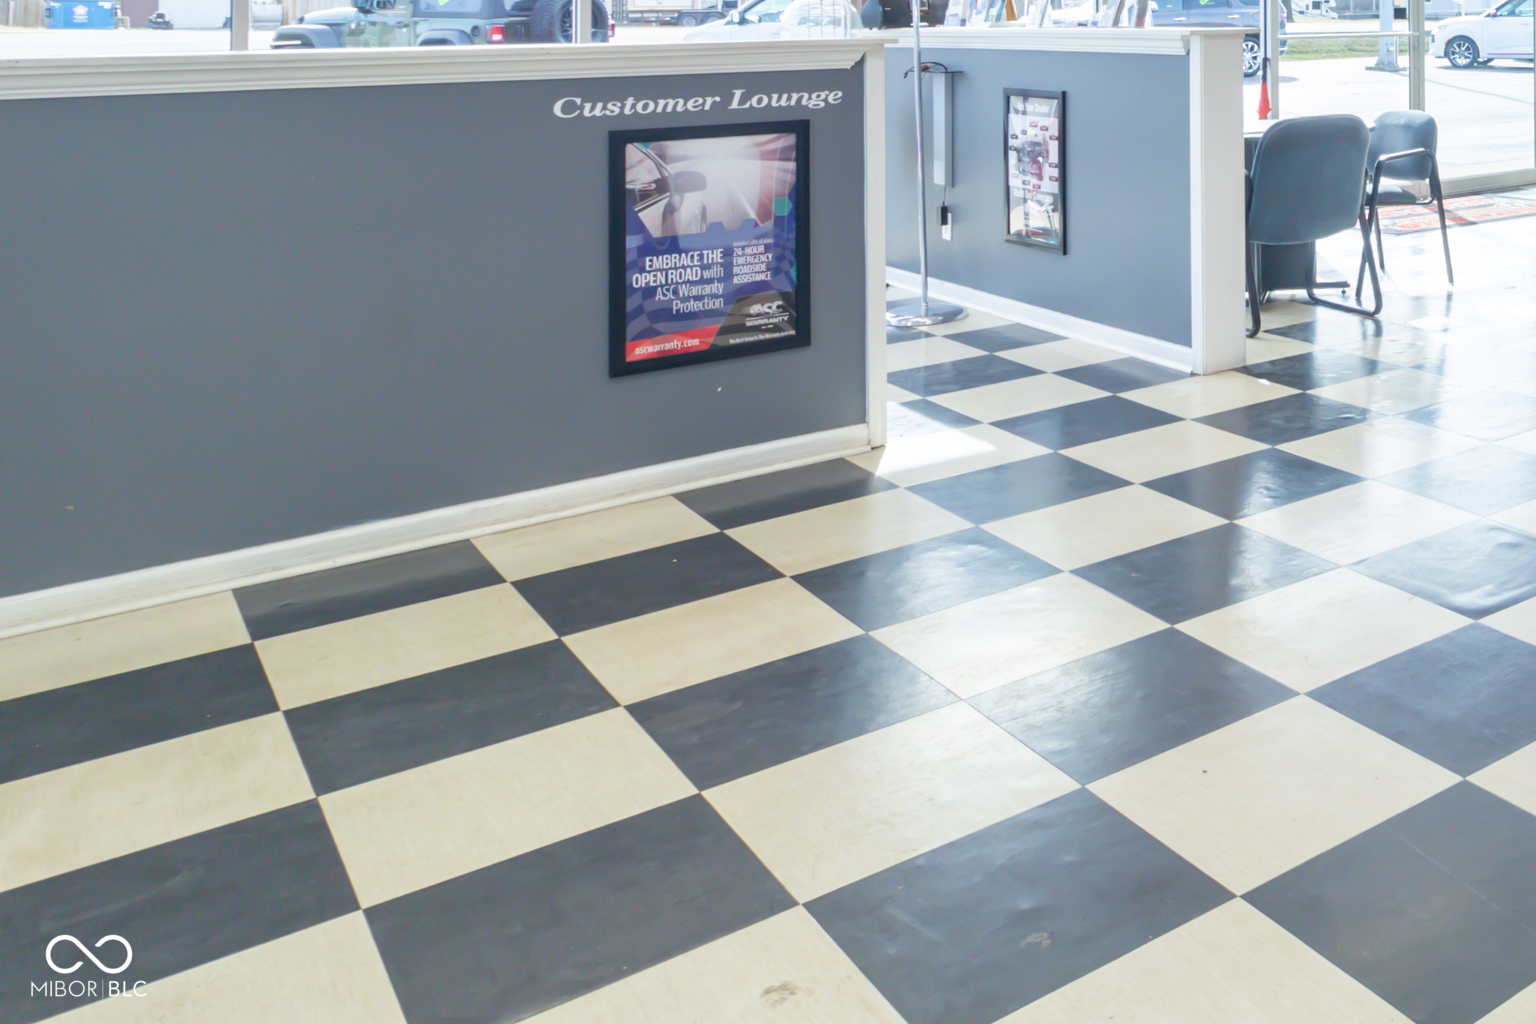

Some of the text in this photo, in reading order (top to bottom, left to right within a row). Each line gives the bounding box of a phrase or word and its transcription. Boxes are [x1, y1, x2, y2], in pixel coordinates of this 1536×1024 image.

[552, 89, 844, 119] Customer Lounge
[733, 244, 765, 256] 24-HOUR
[645, 248, 724, 271] EMBRACE THE
[733, 253, 773, 265] EMERGENCY
[632, 264, 724, 288] OPEN ROAD with
[733, 262, 767, 275] ROADSIDE
[733, 271, 772, 284] ASSISTANCE
[655, 279, 724, 301] ASC Warranty
[672, 295, 724, 314] Protection
[745, 315, 790, 327] WARRANTY
[634, 338, 700, 355] ascwarranty.com
